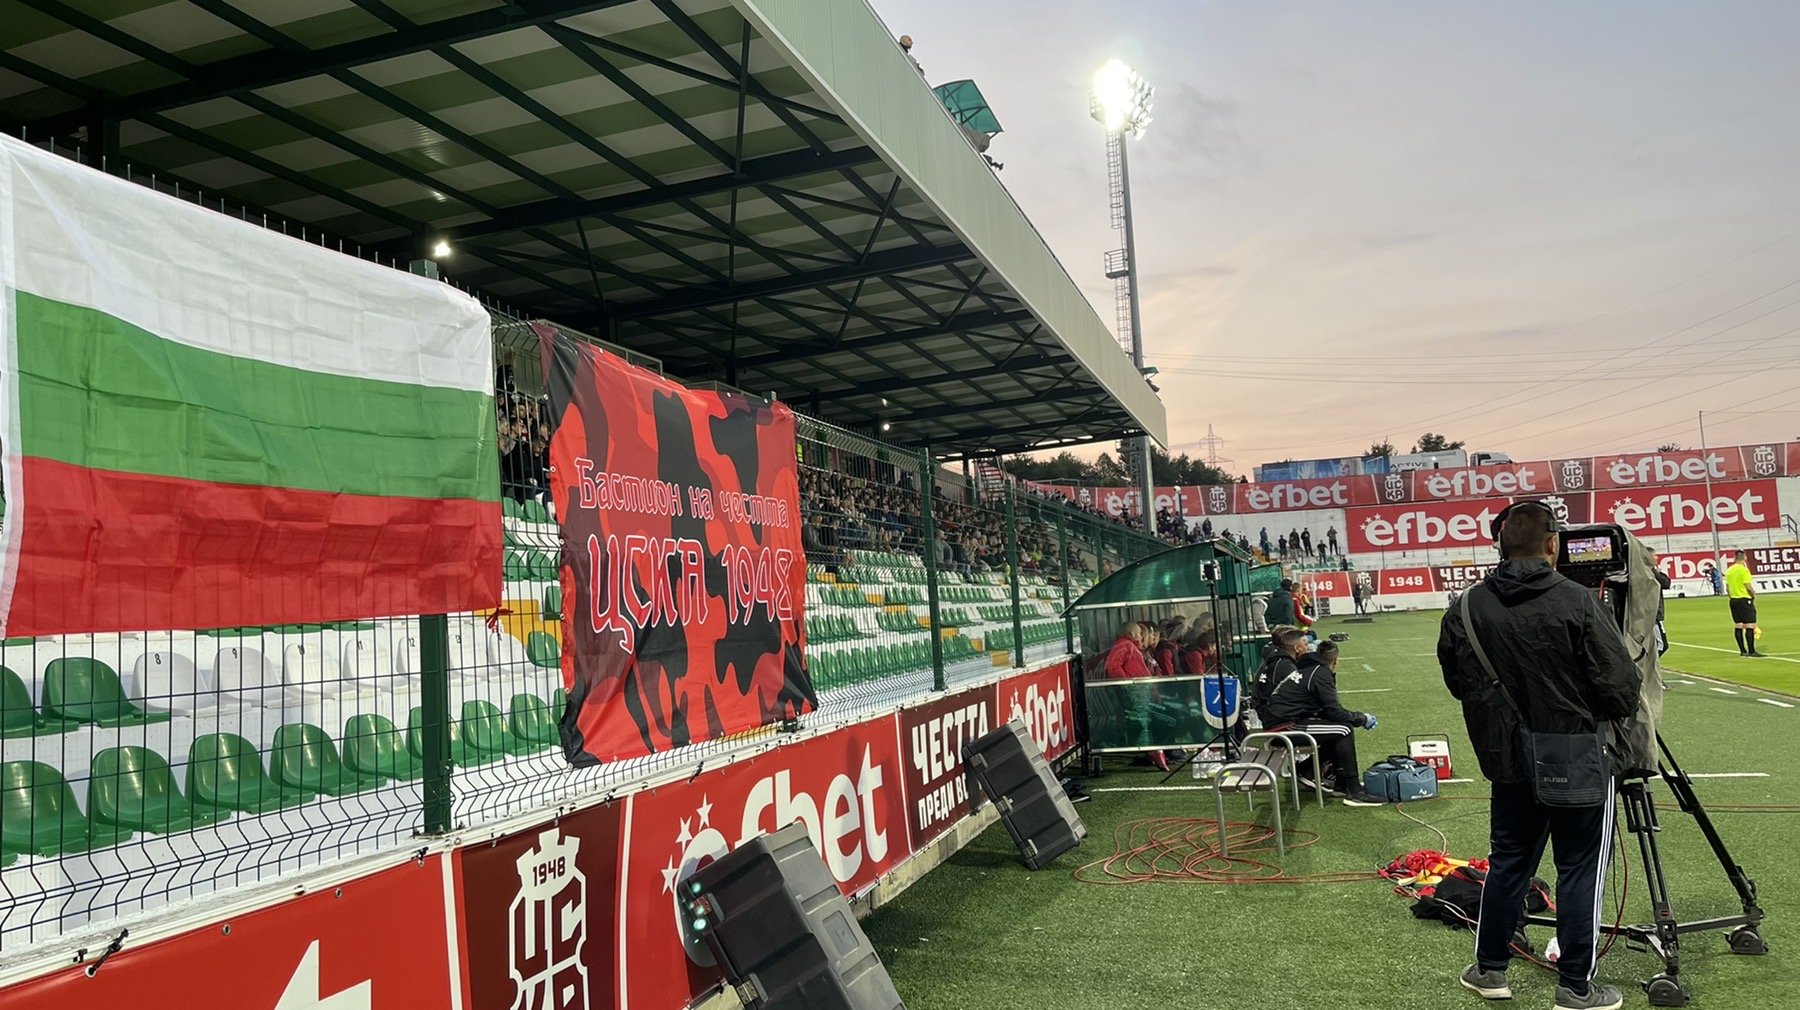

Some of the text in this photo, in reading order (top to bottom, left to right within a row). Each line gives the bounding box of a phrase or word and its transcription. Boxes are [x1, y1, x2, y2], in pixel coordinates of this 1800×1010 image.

[1427, 466, 1536, 498] efbet
[1609, 452, 1726, 485] efbet
[574, 457, 790, 529] Бастион на честта
[1107, 490, 1188, 516] efet
[1249, 480, 1348, 510] efbet
[1614, 488, 1765, 531] efbet
[1365, 507, 1500, 546] efbet
[1389, 575, 1424, 588] 1948
[1659, 553, 1736, 579] fbet
[1757, 563, 1791, 572] ПРЕДИ
[587, 533, 792, 654] ЦСКА 1948
[154, 653, 161, 665] 8
[231, 647, 238, 658] 9
[918, 780, 955, 831] ПРЕДИ
[532, 856, 566, 887] 1948
